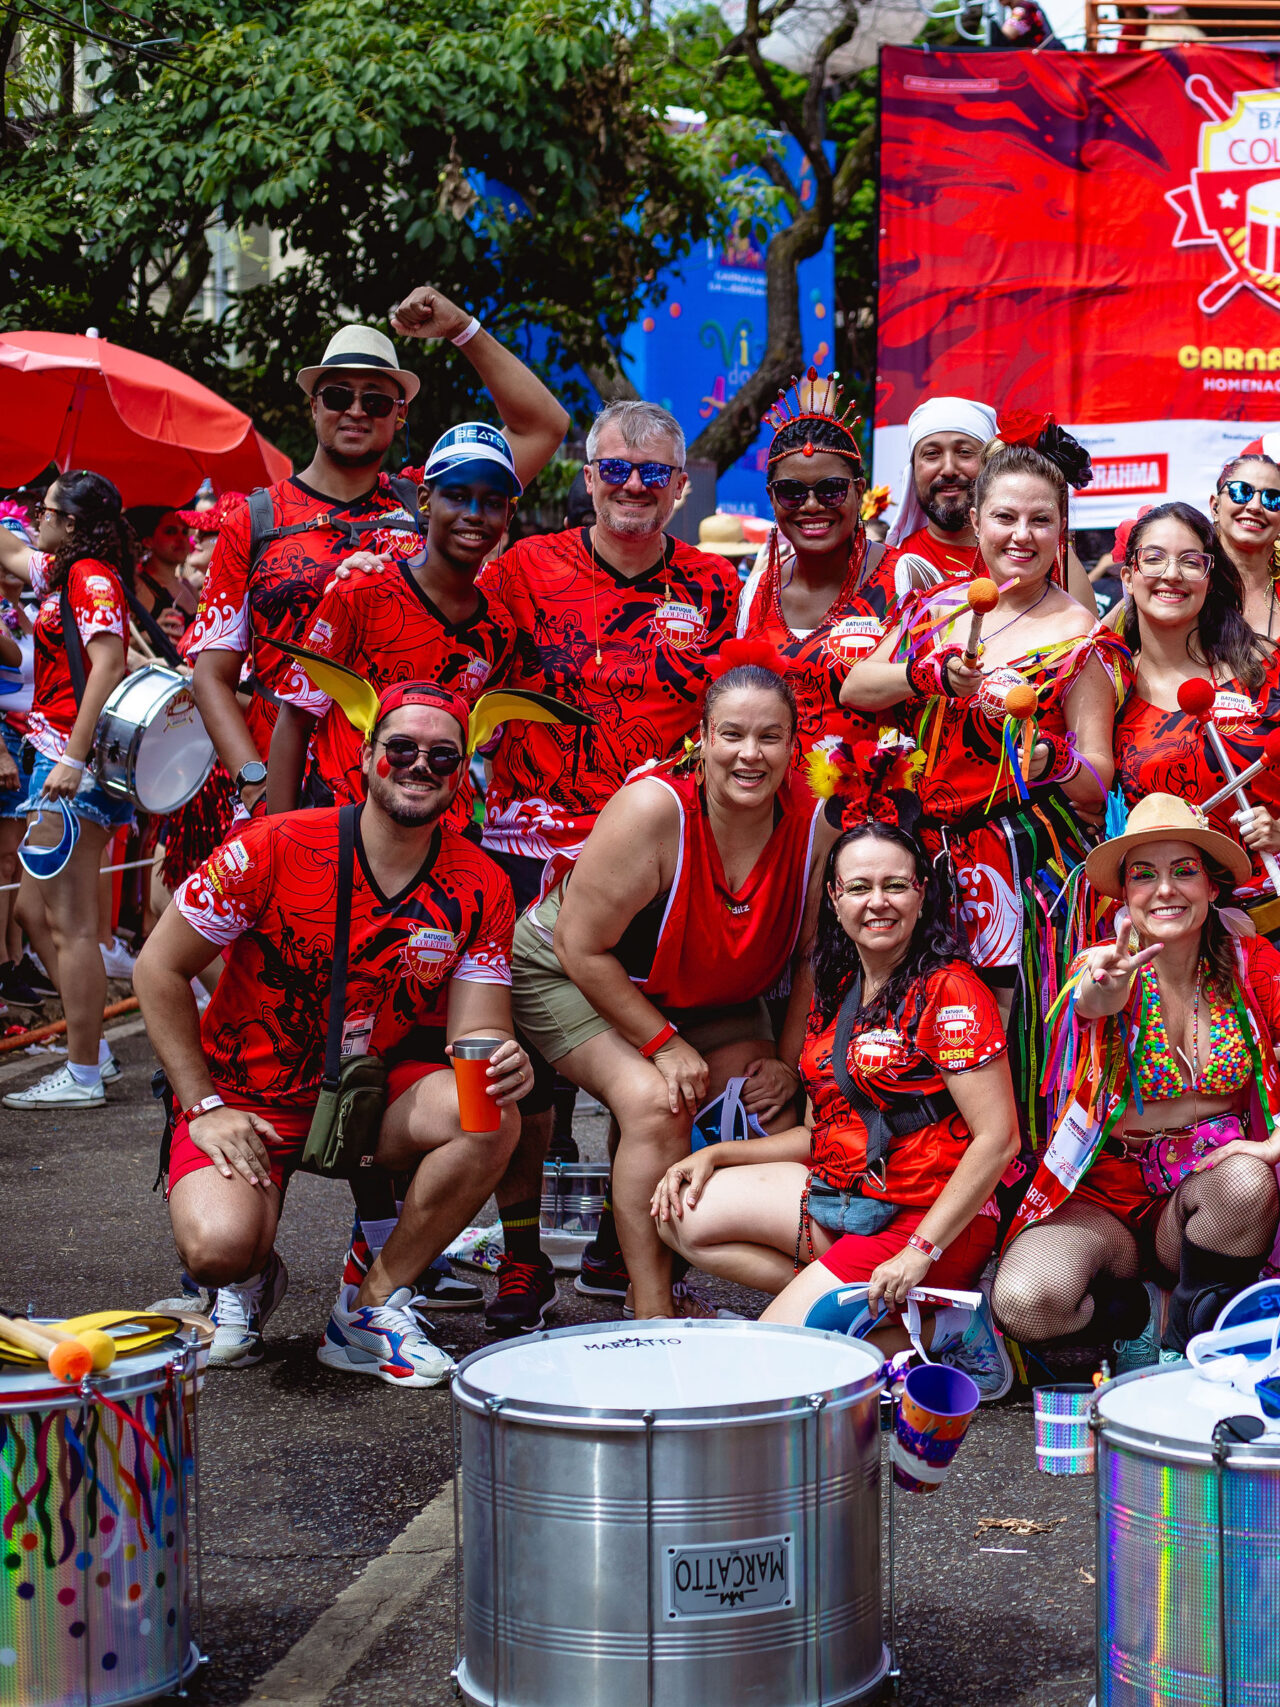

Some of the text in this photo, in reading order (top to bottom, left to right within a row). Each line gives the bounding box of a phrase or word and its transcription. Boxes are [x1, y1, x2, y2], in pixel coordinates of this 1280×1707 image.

[1092, 461, 1161, 490] RAHMA
[669, 605, 693, 614] BATUQUE
[662, 610, 699, 622] COLETIVO
[845, 619, 873, 628] BATUQUE
[423, 932, 448, 942] BATUQUE
[415, 940, 453, 950] COLETIVO
[939, 1048, 975, 1061] DESDE
[948, 1060, 967, 1069] 2017
[583, 1337, 682, 1351] MARCATTO
[675, 1549, 785, 1592] MARCATTO
